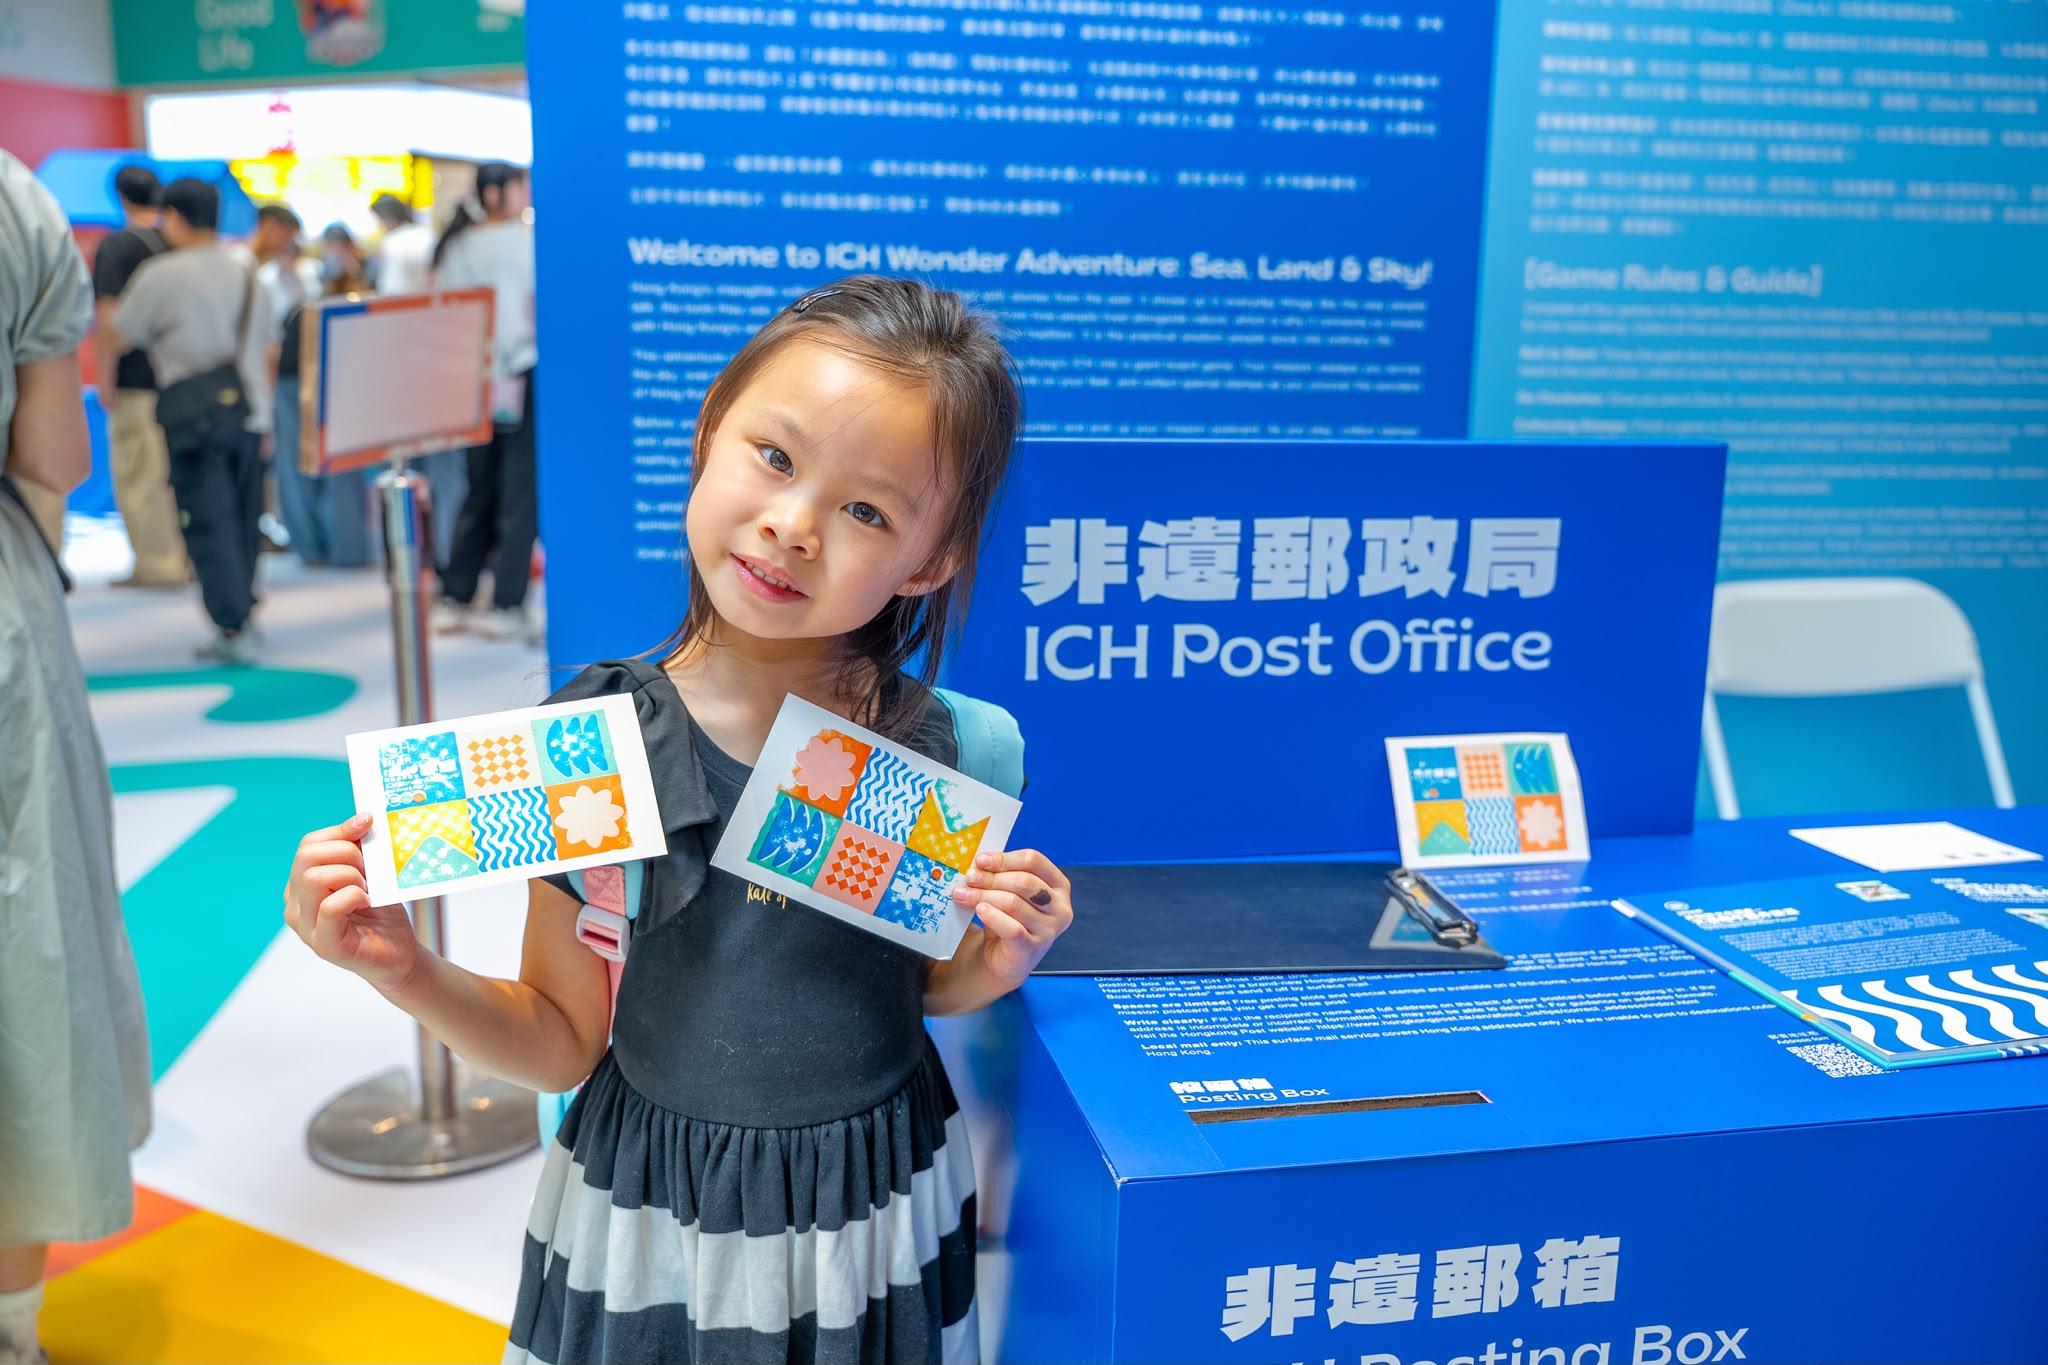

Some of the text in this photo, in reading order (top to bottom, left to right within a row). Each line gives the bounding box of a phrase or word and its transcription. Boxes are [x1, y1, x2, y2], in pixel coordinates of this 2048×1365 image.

[628, 237, 779, 269] Welcome
[785, 242, 821, 269] to
[826, 242, 880, 270] ICH
[886, 244, 1008, 274] Wonder
[1258, 254, 1334, 282] Land
[1340, 255, 1362, 282] &
[1368, 256, 1432, 290] Sky!
[1622, 262, 1701, 293] Rules
[1020, 516, 1562, 606] 非遺郵政局
[1024, 617, 1553, 681] ICH Post Office
[1098, 981, 1138, 989] posting
[1247, 980, 1302, 988] brand-new
[1303, 976, 1358, 985] Hongkong
[1260, 996, 1299, 1004] posting
[1349, 989, 1387, 998] special
[1388, 987, 1426, 995] stamps
[1307, 983, 1345, 991] surface
[1118, 1008, 1160, 1016] mission
[1162, 1006, 1209, 1015] postcard
[1235, 1004, 1255, 1012] you
[1129, 1025, 1175, 1033] address
[1189, 1021, 1250, 1031] incomplete
[1266, 1017, 1323, 1027] incorrectly
[1400, 1011, 1424, 1019] may
[1568, 999, 1616, 1008] guidance
[1162, 1017, 1209, 1026] clearly:
[1264, 1011, 1320, 1020] recipient's
[1395, 1003, 1438, 1011] address
[1474, 999, 1501, 1007] back
[1584, 992, 1620, 1000] before
[1180, 1029, 1239, 1038] Hongkong
[1210, 1040, 1243, 1048] only:
[1271, 1036, 1314, 1045] surface
[1315, 1034, 1339, 1042] mail
[1340, 1031, 1381, 1040] service
[1382, 1029, 1420, 1037] covers
[1419, 1027, 1451, 1035] Hong
[1481, 1021, 1537, 1031] addresses
[1604, 1014, 1640, 1022] unable
[1652, 1011, 1677, 1019] post
[1688, 1006, 1751, 1016] destinations
[1178, 1088, 1331, 1104] Posting Box
[1220, 1235, 1621, 1342] 非遺郵箱
[1632, 1324, 1750, 1365] Box
